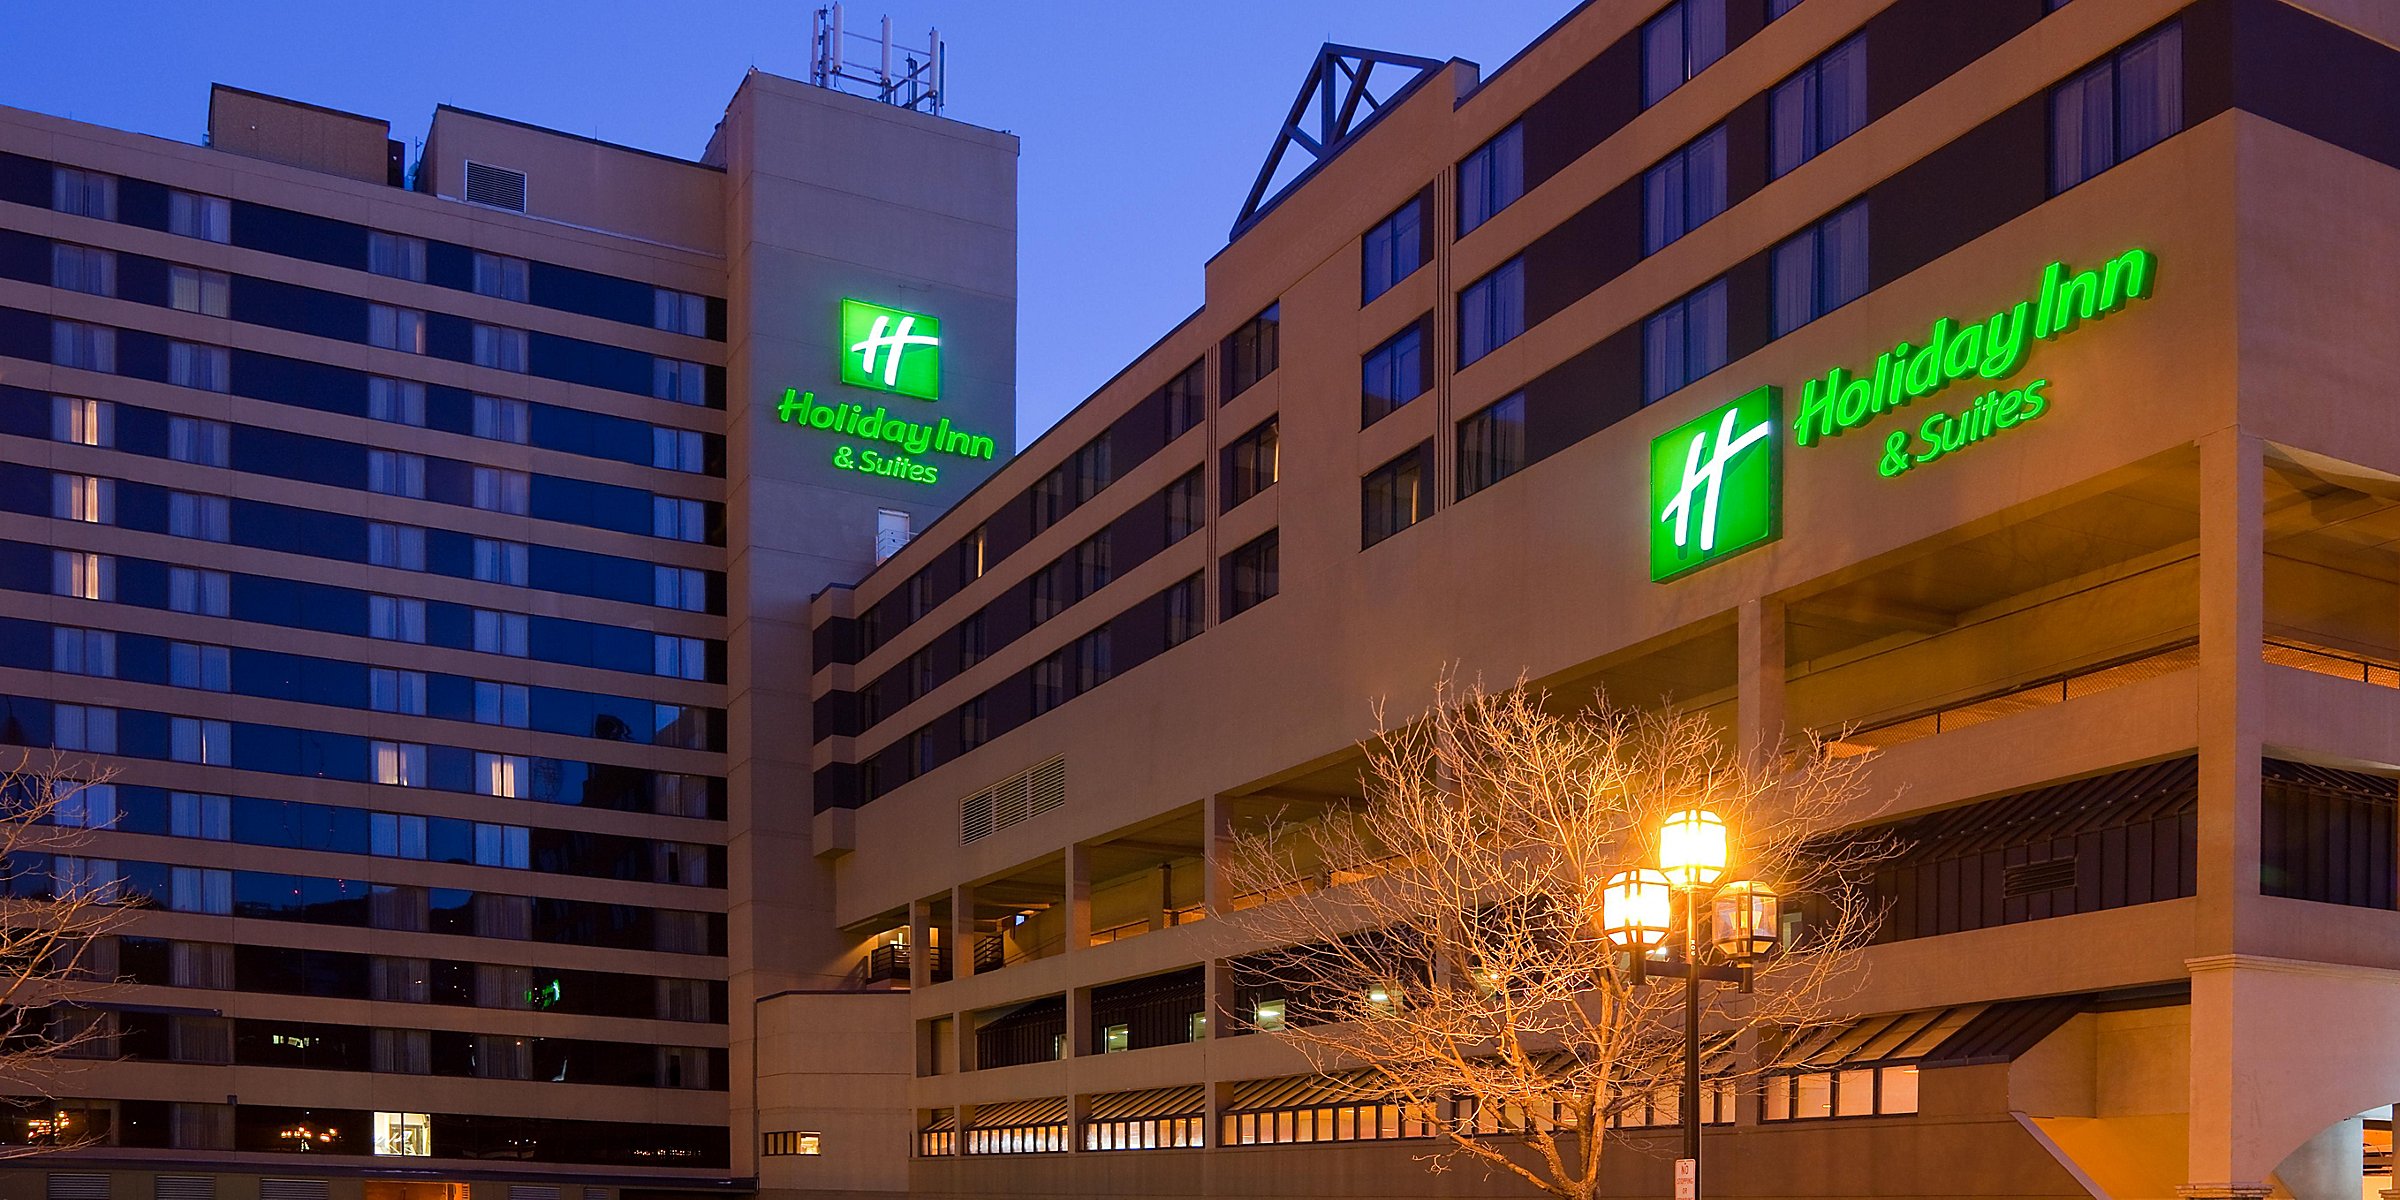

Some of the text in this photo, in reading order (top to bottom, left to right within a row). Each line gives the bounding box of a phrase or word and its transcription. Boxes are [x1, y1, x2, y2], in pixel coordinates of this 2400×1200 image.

[1793, 248, 2152, 447] Holiday Inn
[778, 388, 995, 460] Holiday Inn
[832, 445, 938, 484] & Suites
[1878, 379, 2047, 477] & Suites
